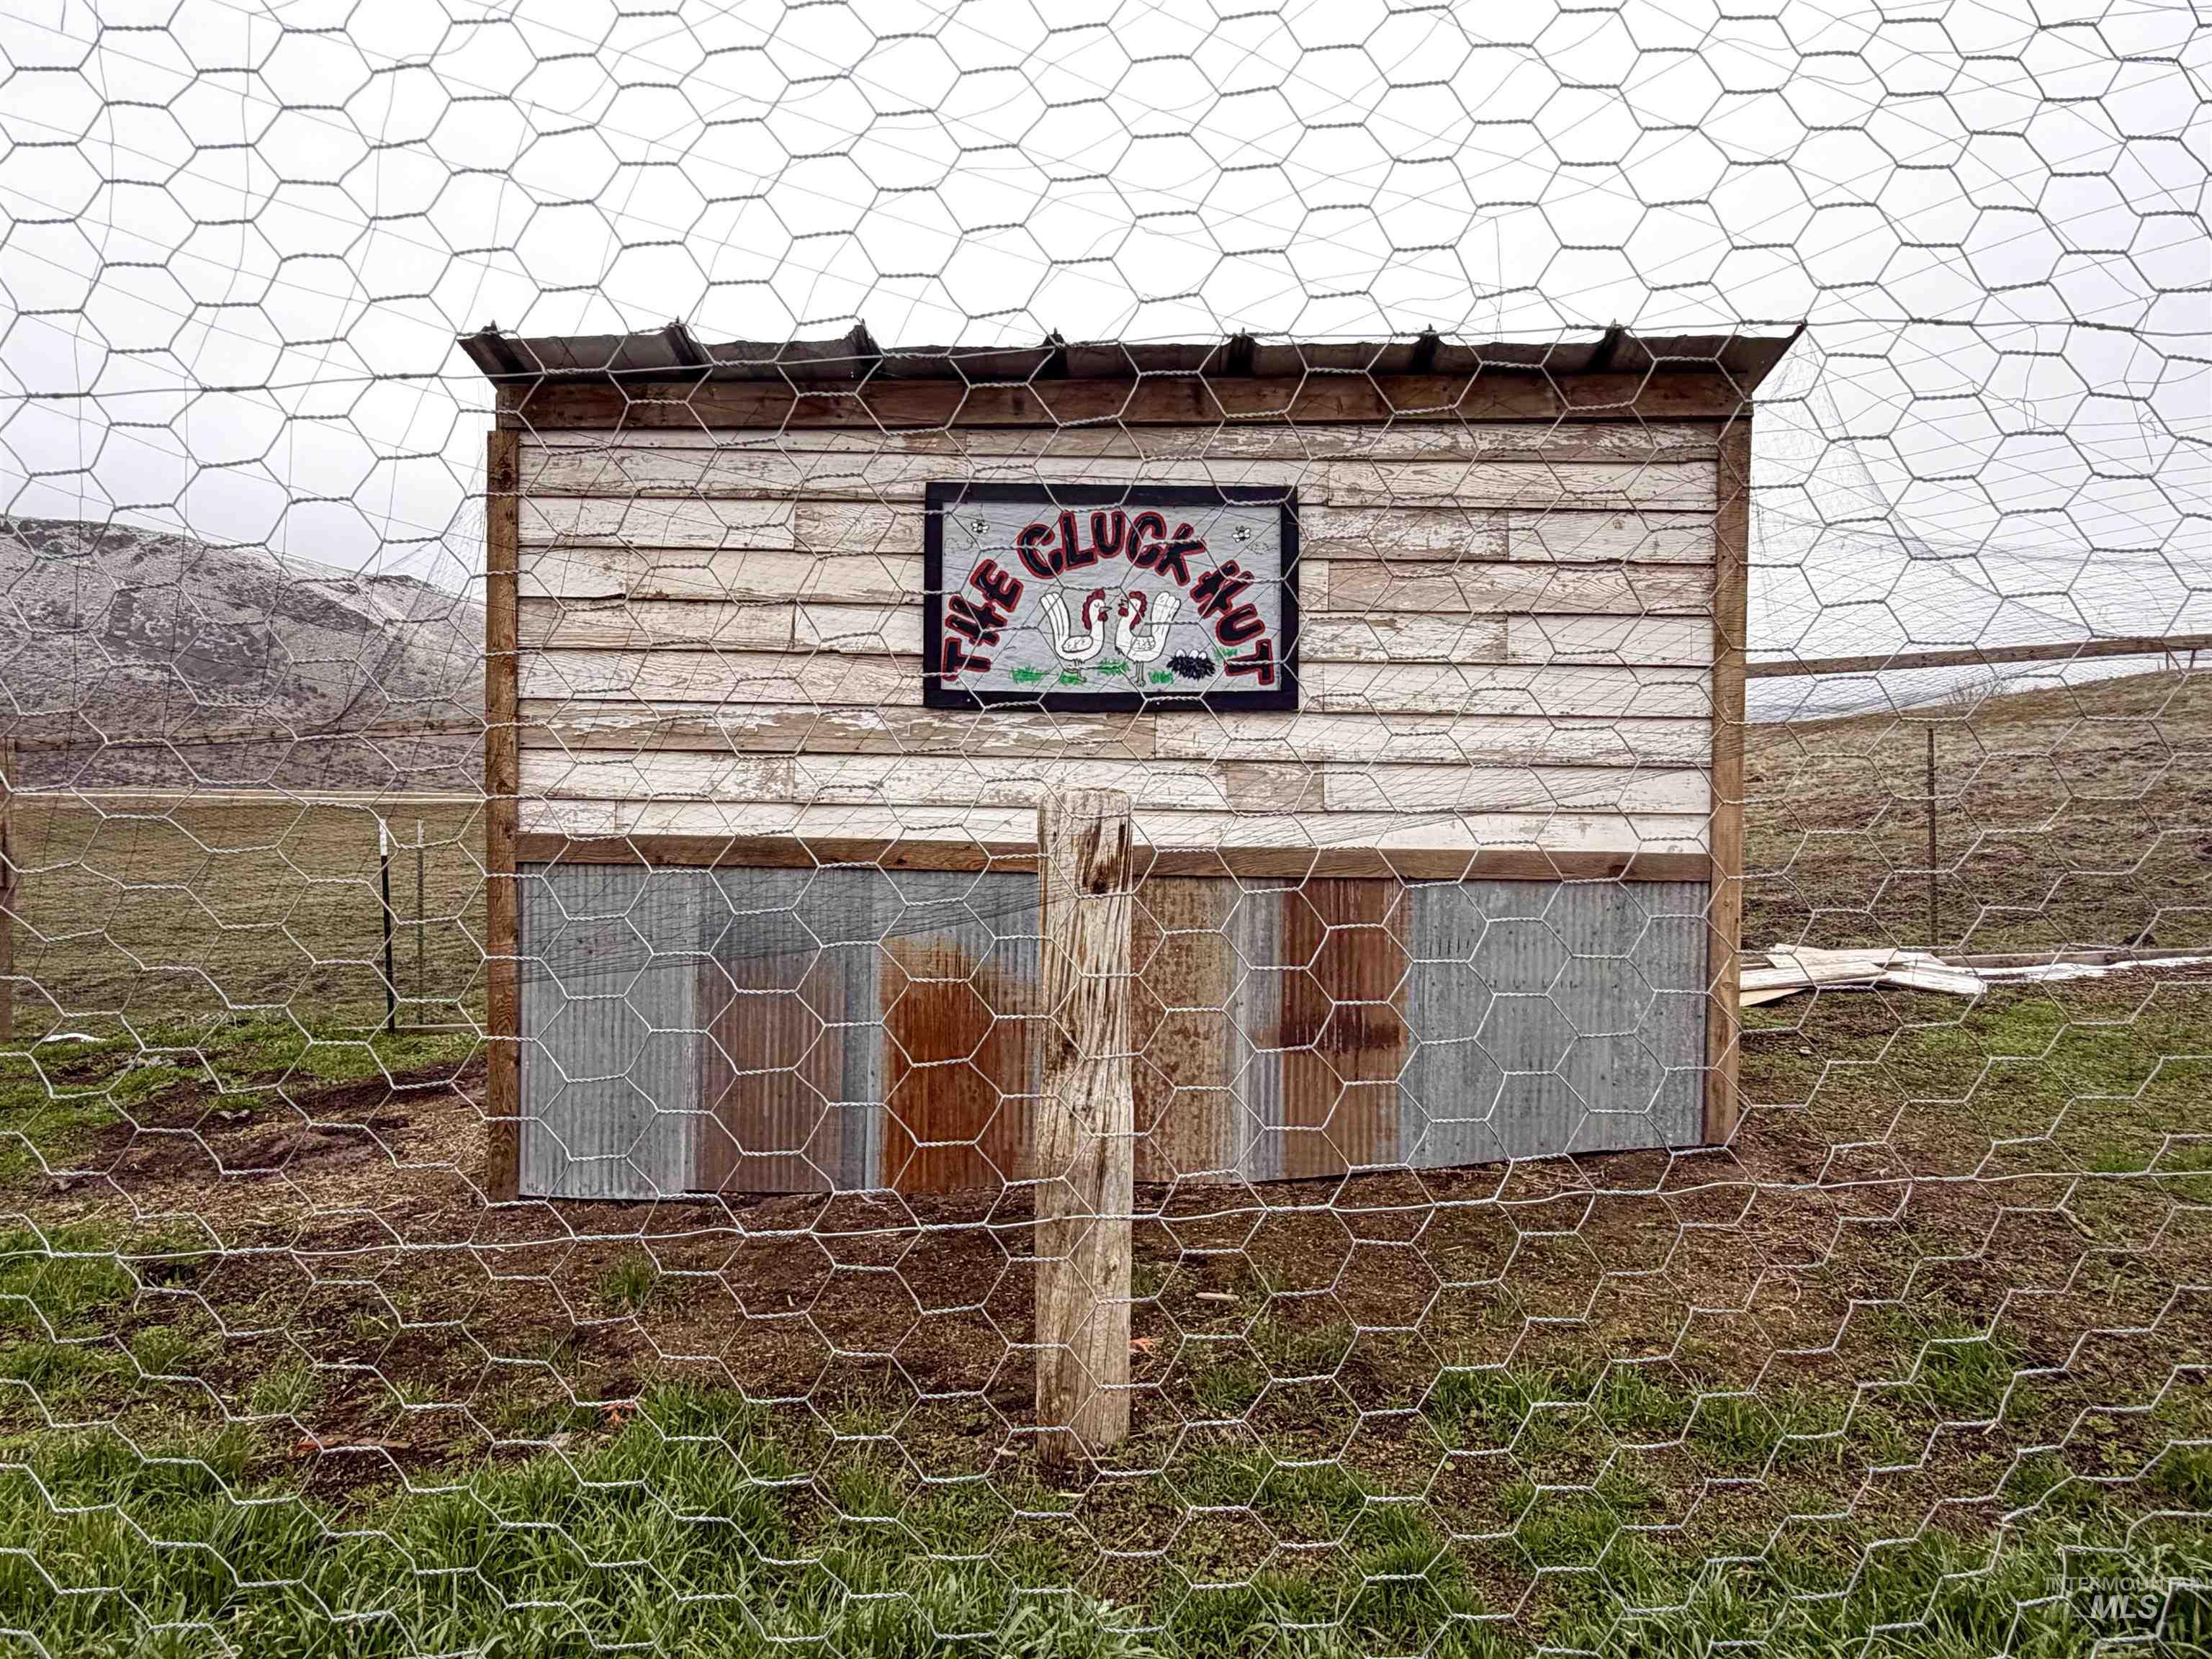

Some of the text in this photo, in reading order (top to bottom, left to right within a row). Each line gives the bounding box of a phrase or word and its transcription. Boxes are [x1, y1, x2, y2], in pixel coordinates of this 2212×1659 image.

[940, 511, 1274, 685] THE CLUCK HUT
